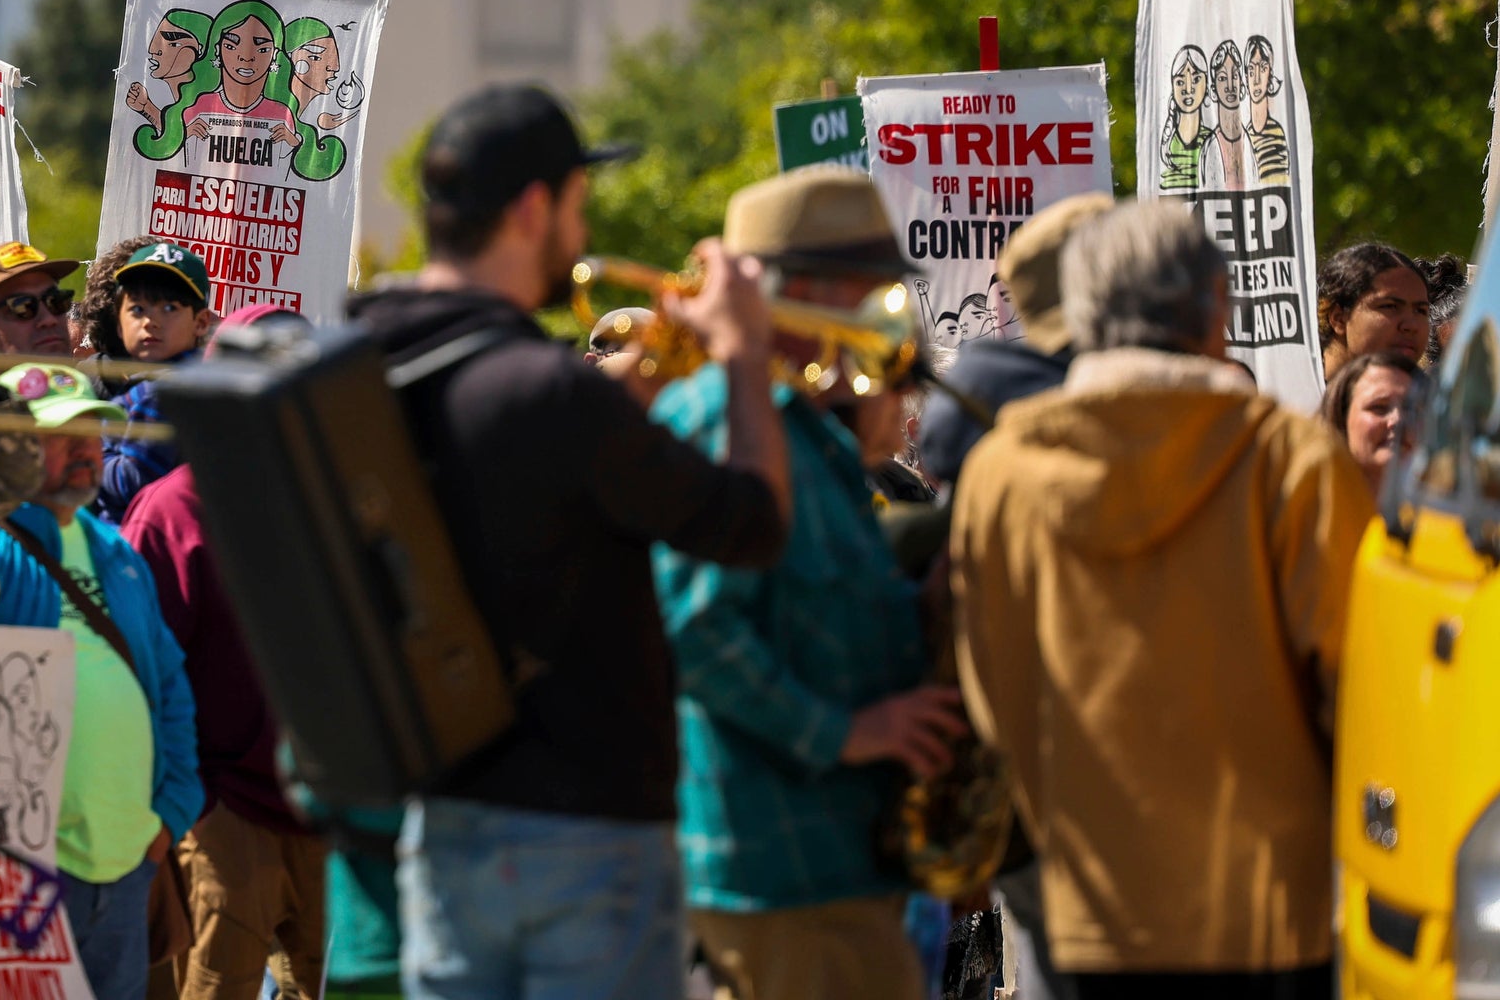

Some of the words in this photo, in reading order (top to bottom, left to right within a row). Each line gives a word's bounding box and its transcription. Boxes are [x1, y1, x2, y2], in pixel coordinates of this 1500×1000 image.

[943, 95, 991, 115] READY
[996, 94, 1016, 114] TO
[209, 117, 242, 127] PREPARADOS
[811, 107, 849, 146] ON
[208, 134, 273, 167] HUELGA
[878, 122, 1094, 166] STRIKE
[153, 185, 186, 207] PARA
[188, 175, 301, 223] ESCUELAS
[933, 176, 960, 194] FOR
[968, 176, 1034, 215] FAIR
[942, 195, 952, 214] A
[1184, 193, 1288, 252] EEP
[908, 219, 1024, 260] CONTR
[270, 254, 285, 286] Y
[1272, 261, 1293, 287] IN
